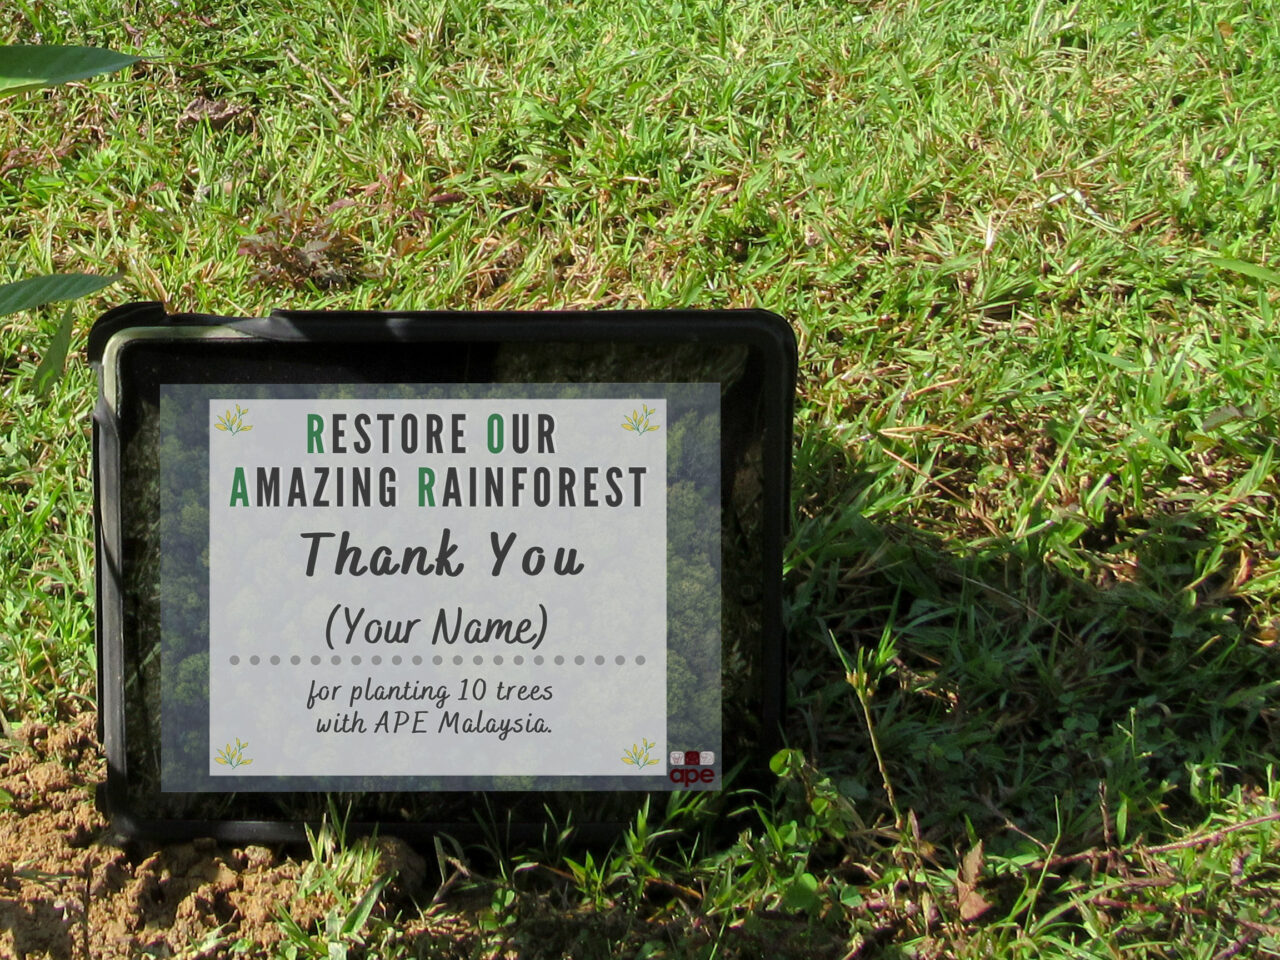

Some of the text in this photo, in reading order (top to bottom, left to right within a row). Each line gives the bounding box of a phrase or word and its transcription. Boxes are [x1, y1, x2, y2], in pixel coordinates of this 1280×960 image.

[307, 413, 556, 455] RESTORE OUR
[229, 466, 647, 508] AMAZING RAINFOREST
[300, 527, 585, 578] Thank You
[325, 603, 548, 651] (Your Name)
[306, 676, 553, 710] for planting 10 trees
[316, 709, 552, 742] with APE Malaysia.
[669, 768, 715, 788] ape
